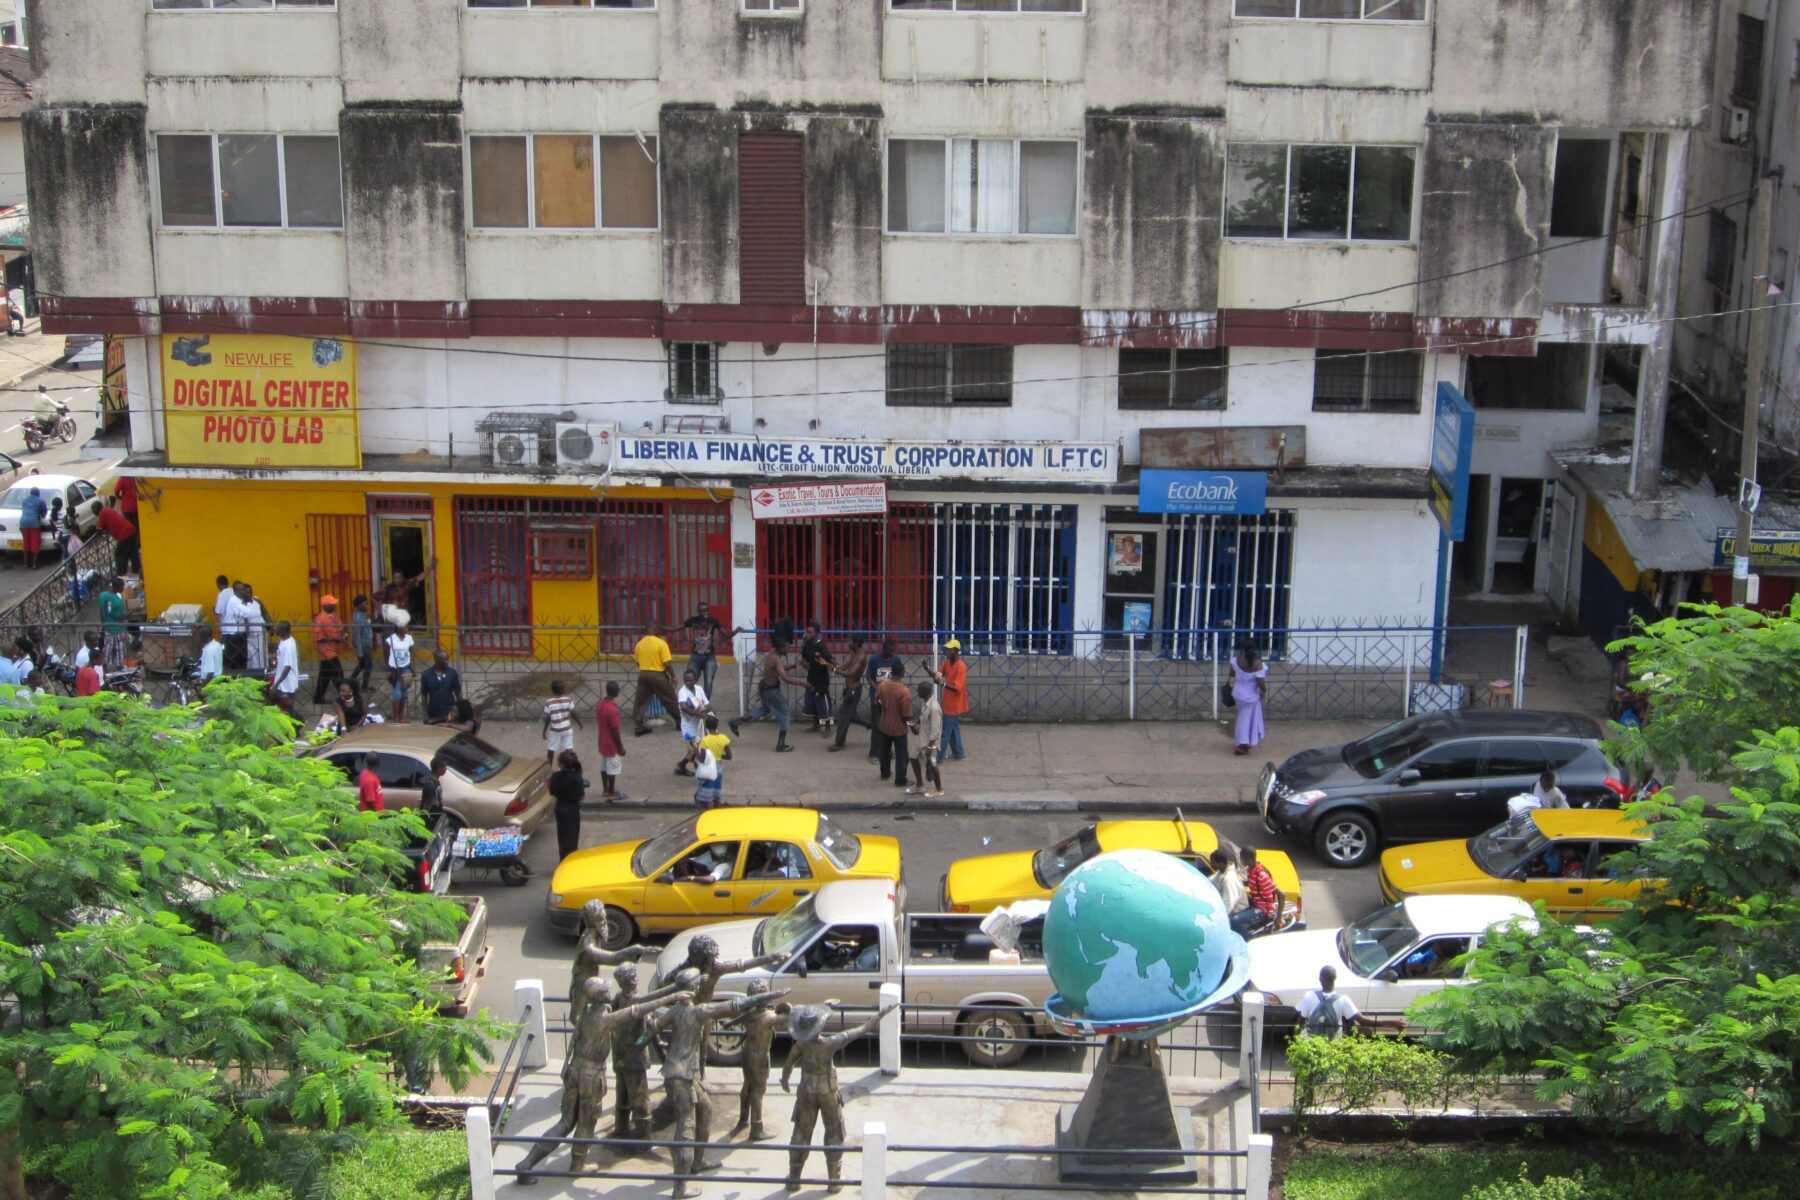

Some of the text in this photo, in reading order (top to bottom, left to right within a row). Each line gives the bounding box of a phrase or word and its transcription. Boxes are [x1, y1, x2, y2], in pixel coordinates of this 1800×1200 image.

[224, 352, 293, 366] NEWLIFE
[173, 379, 349, 408] DIGITAL CENTER
[203, 416, 324, 444] PHOTO LAB
[620, 439, 1108, 470] LIBERIA FINANCE & TRUST CORPORATION (LFTC)
[758, 463, 807, 472] LFTC-CREDIT
[898, 465, 930, 475] LIBERIA
[778, 488, 796, 500] Exotic
[817, 486, 834, 498] Tours
[834, 485, 840, 497] &
[840, 483, 884, 497] Documentation
[1167, 477, 1239, 500] Ecobank
